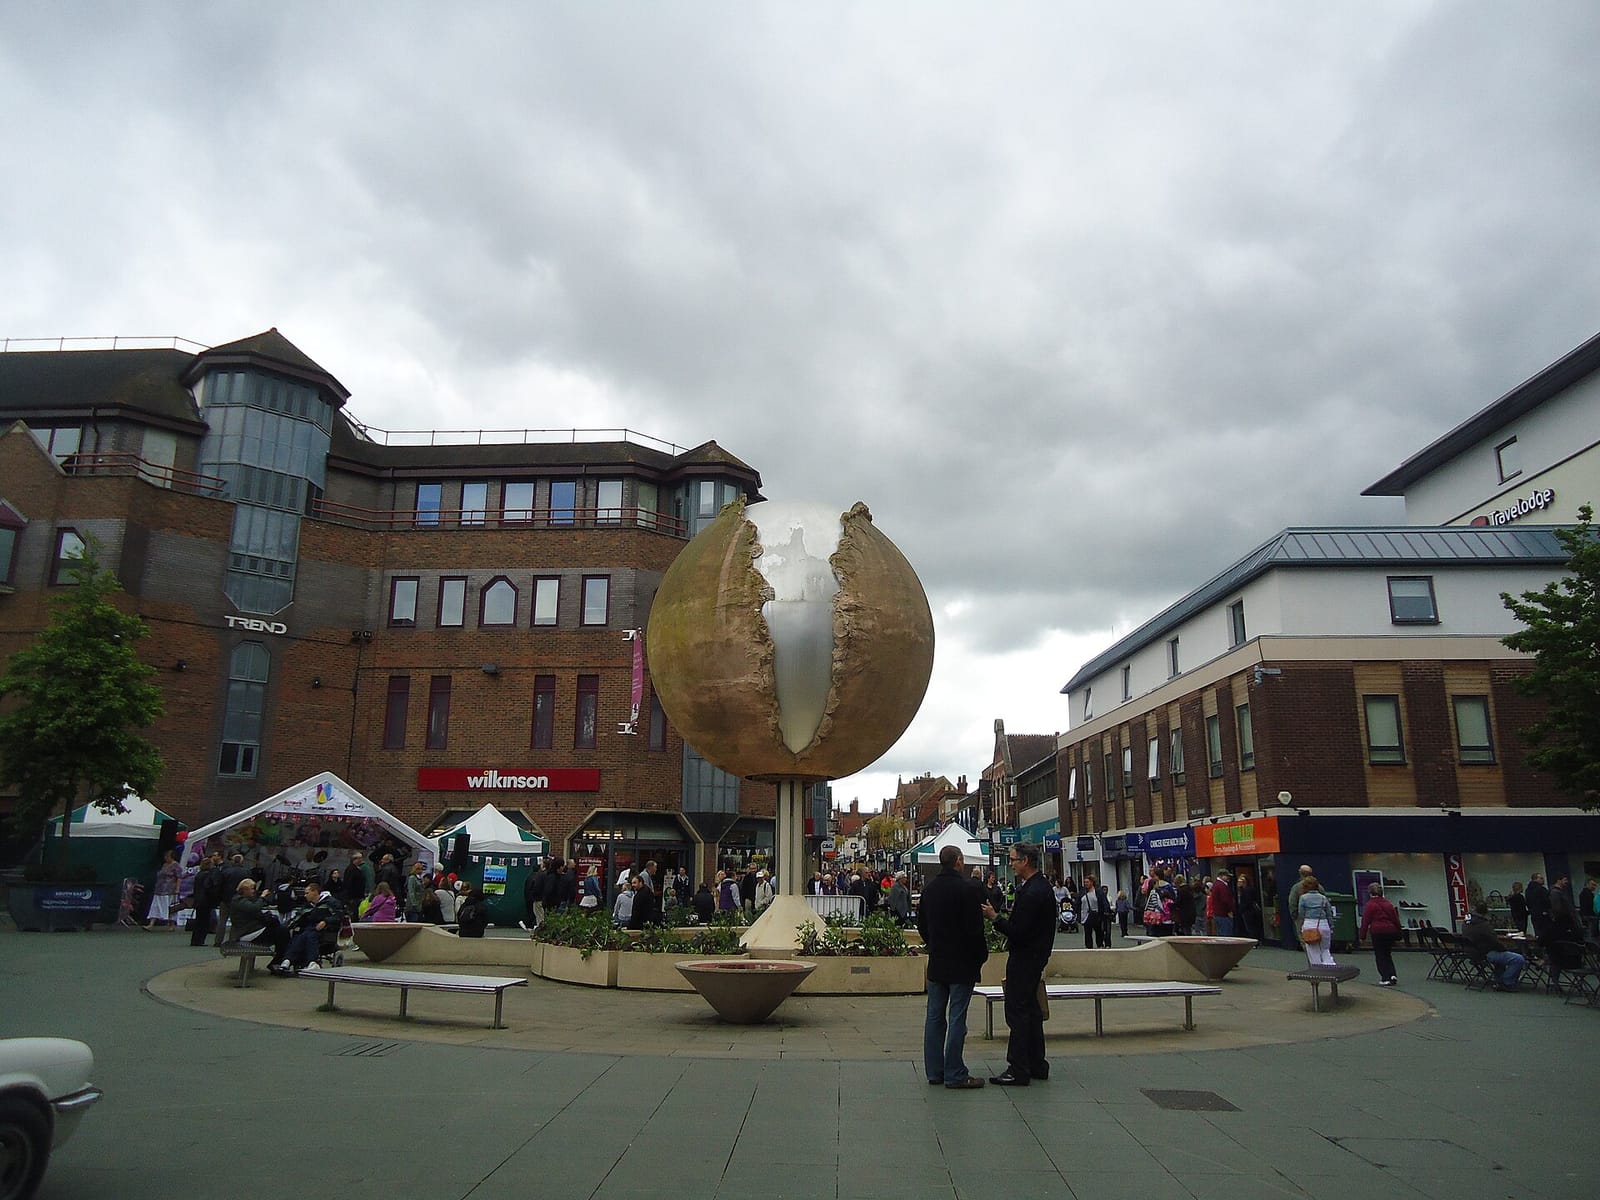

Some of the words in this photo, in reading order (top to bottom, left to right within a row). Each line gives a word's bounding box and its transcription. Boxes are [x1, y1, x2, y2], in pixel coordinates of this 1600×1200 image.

[1489, 488, 1551, 525] Travelodge
[224, 615, 288, 634] TREND
[467, 770, 549, 789] wilkinson
[1450, 855, 1466, 919] SALE
